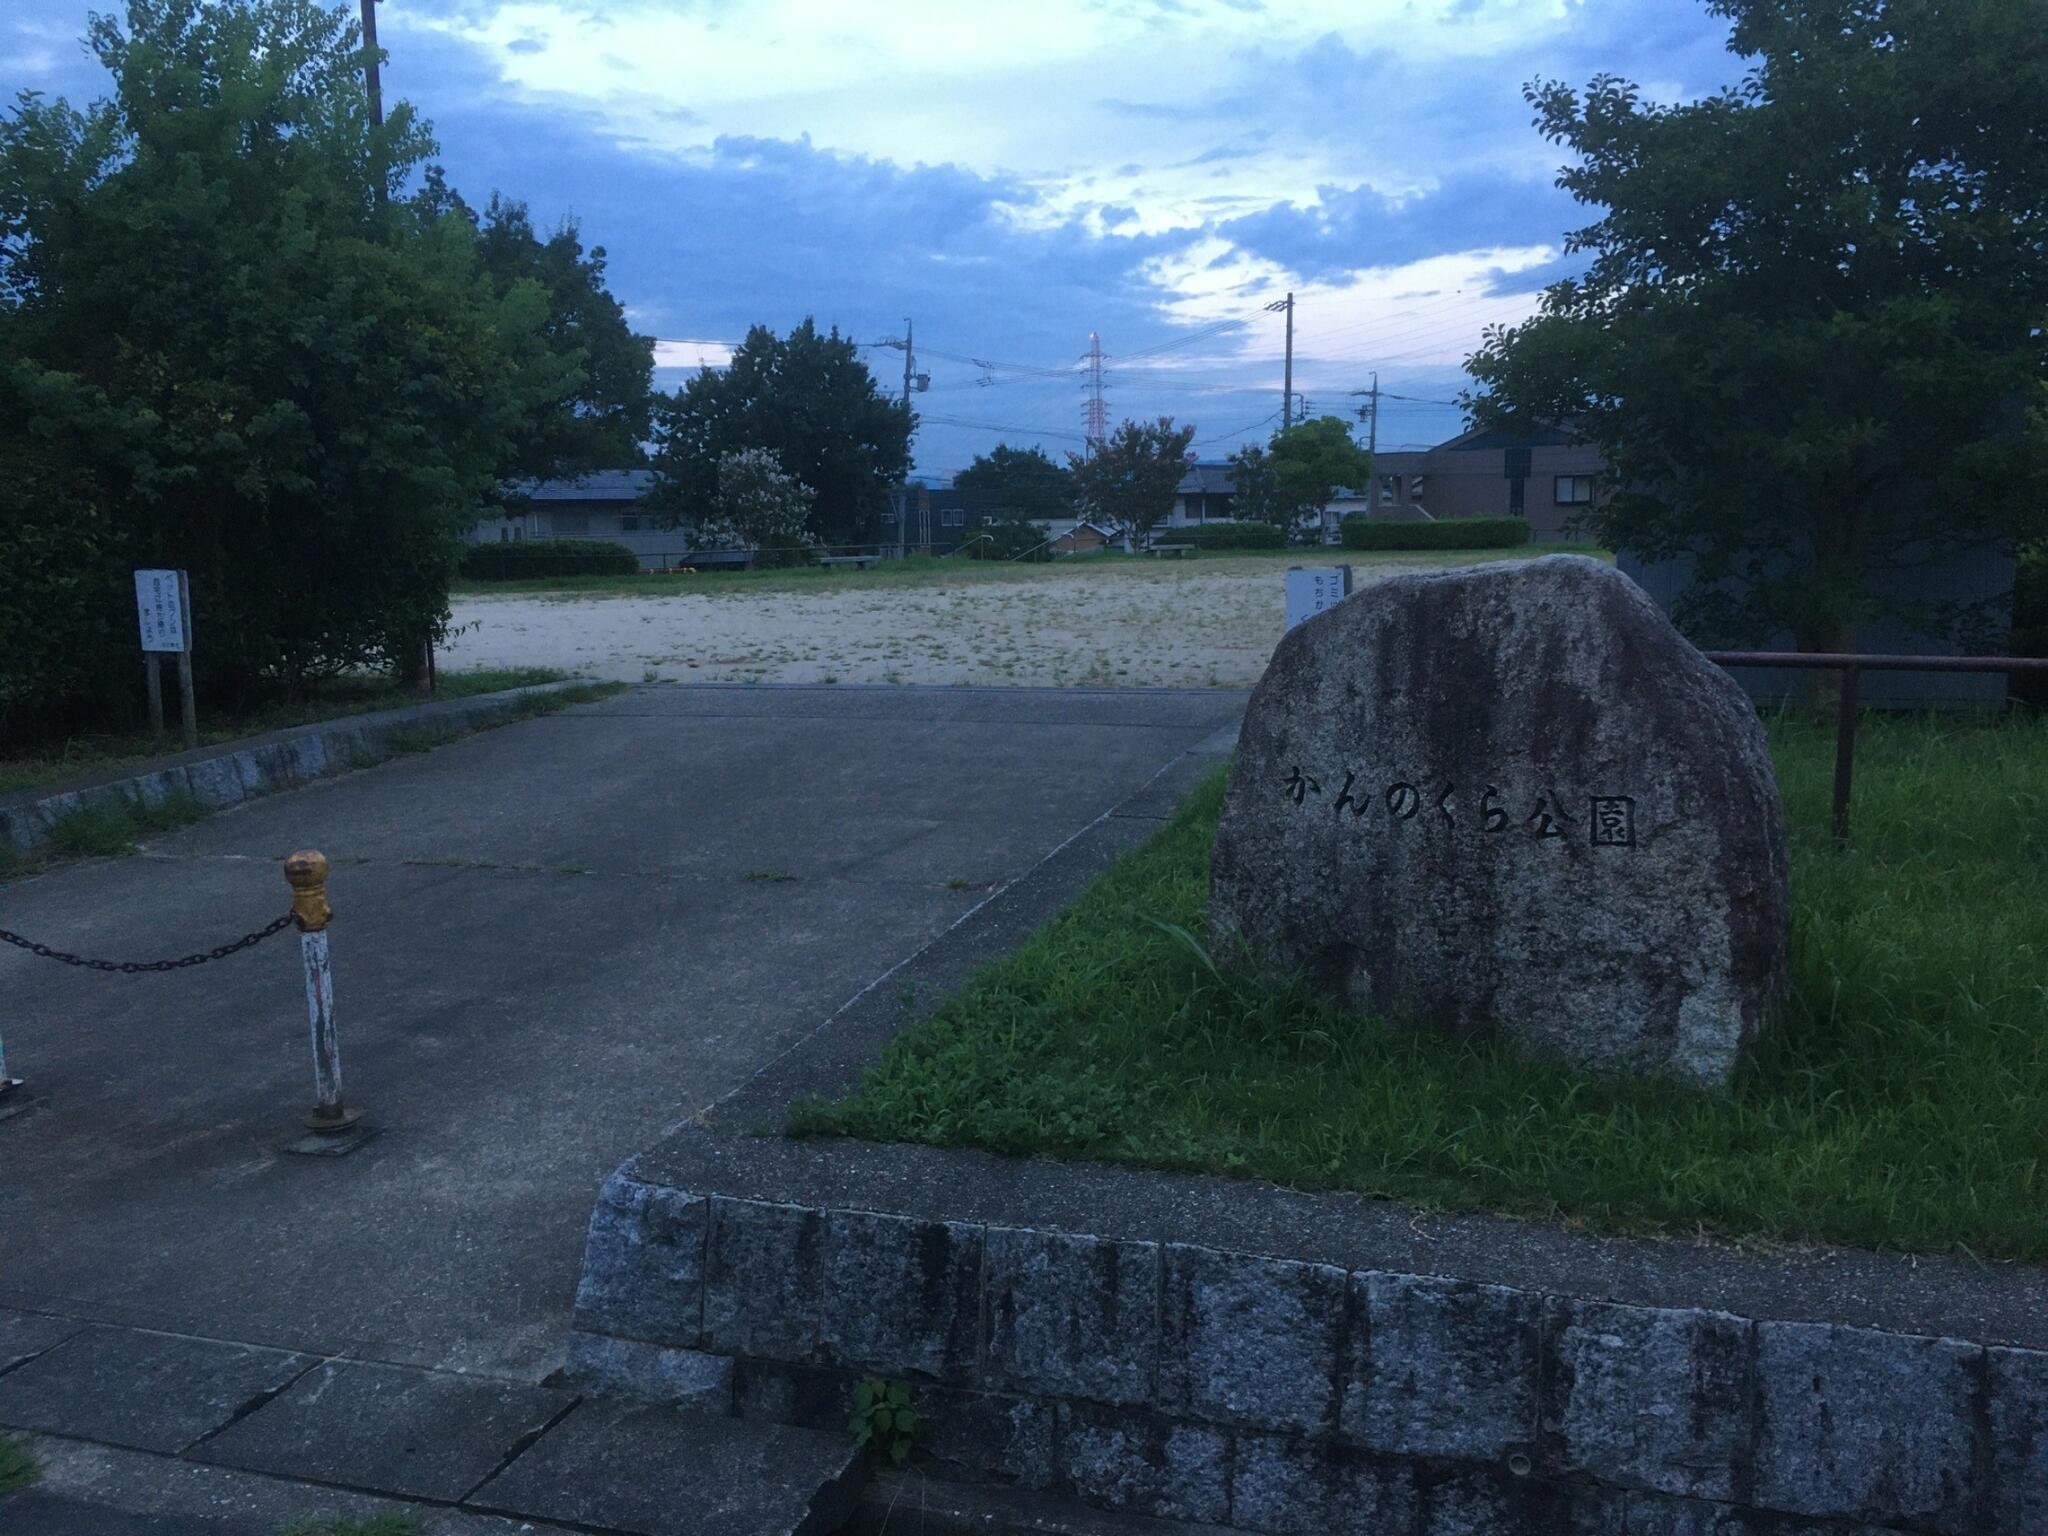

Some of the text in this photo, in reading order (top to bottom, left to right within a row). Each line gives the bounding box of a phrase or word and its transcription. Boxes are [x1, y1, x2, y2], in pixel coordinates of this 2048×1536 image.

[1281, 766, 1637, 848] かんのくら公園
